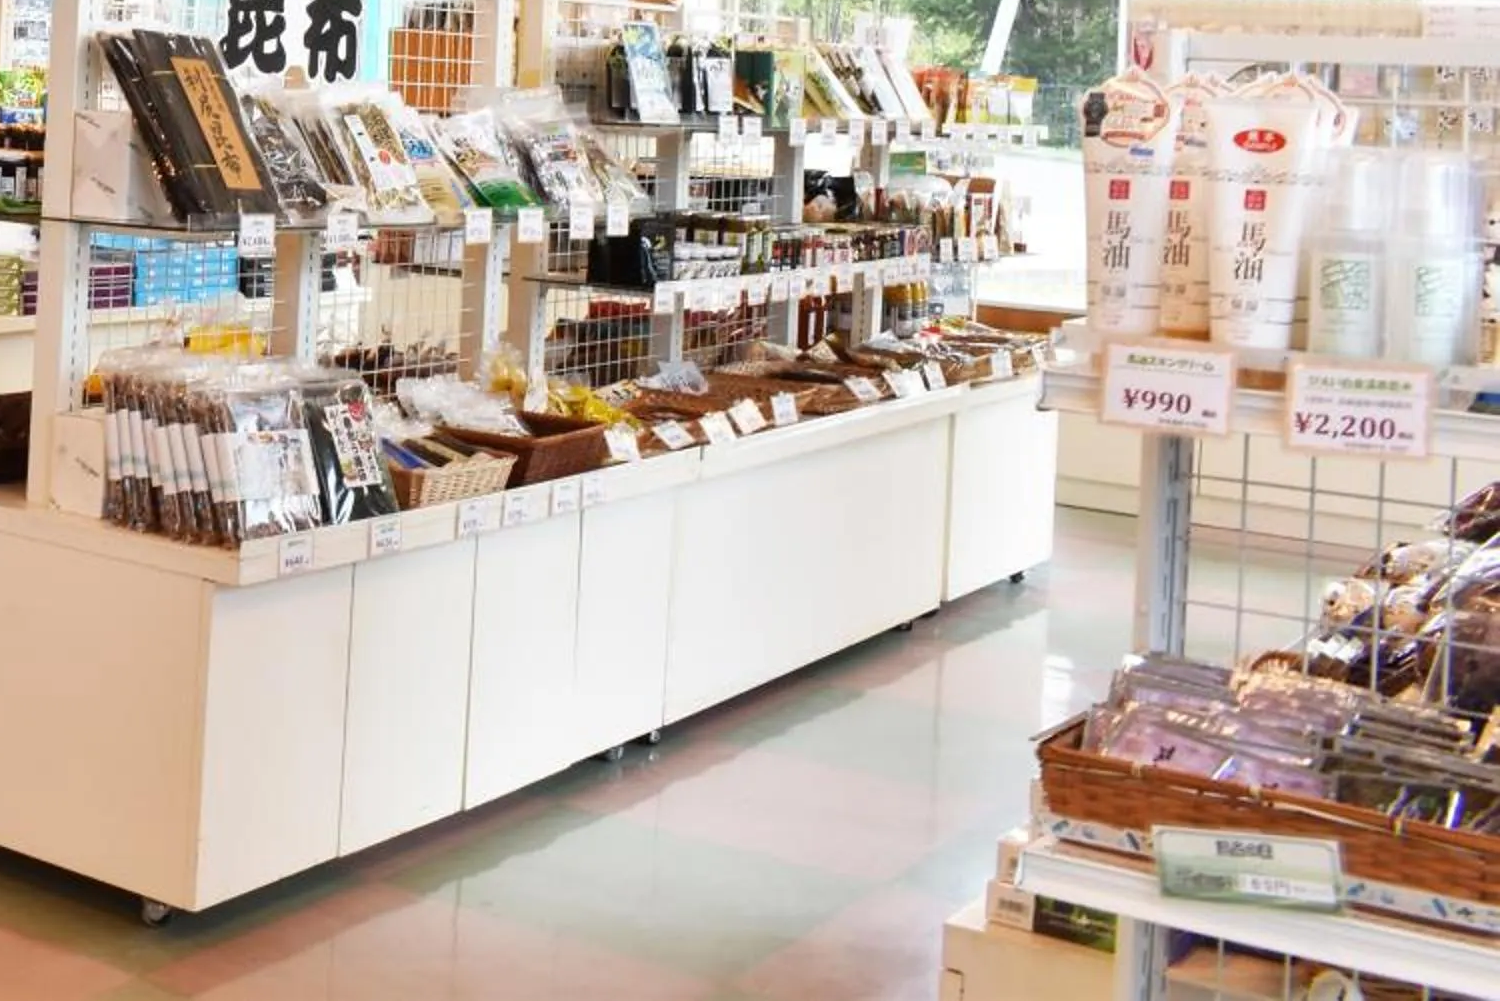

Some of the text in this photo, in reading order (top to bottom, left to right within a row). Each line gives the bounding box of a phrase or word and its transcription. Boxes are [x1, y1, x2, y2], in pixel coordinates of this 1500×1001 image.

[1103, 209, 1131, 271] 馬油
[1163, 209, 1191, 267] 馬油
[1234, 220, 1266, 283] 馬油
[1123, 387, 1192, 416] ¥990
[1294, 411, 1396, 440] ¥2,200
